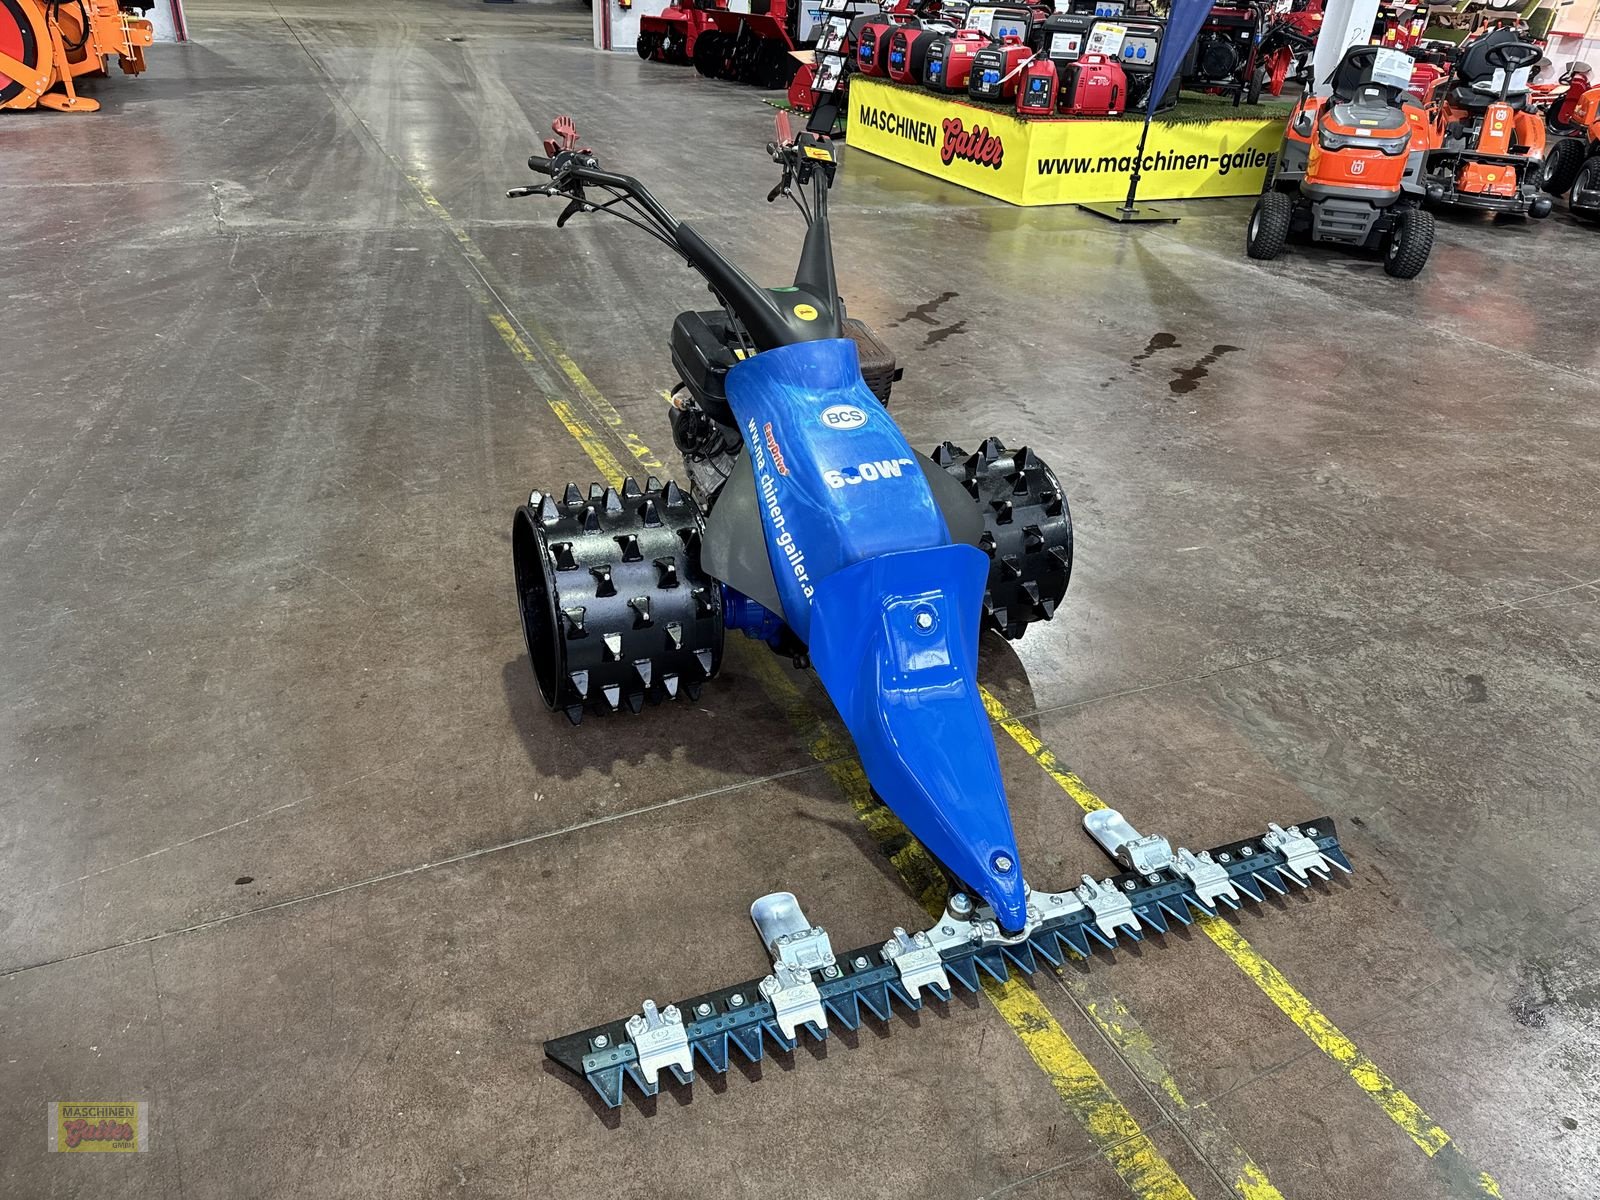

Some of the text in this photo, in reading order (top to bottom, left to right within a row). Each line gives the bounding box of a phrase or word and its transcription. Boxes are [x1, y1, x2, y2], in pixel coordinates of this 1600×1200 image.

[860, 104, 1004, 170] MASCHINEN Gailer
[826, 410, 863, 424] BCS
